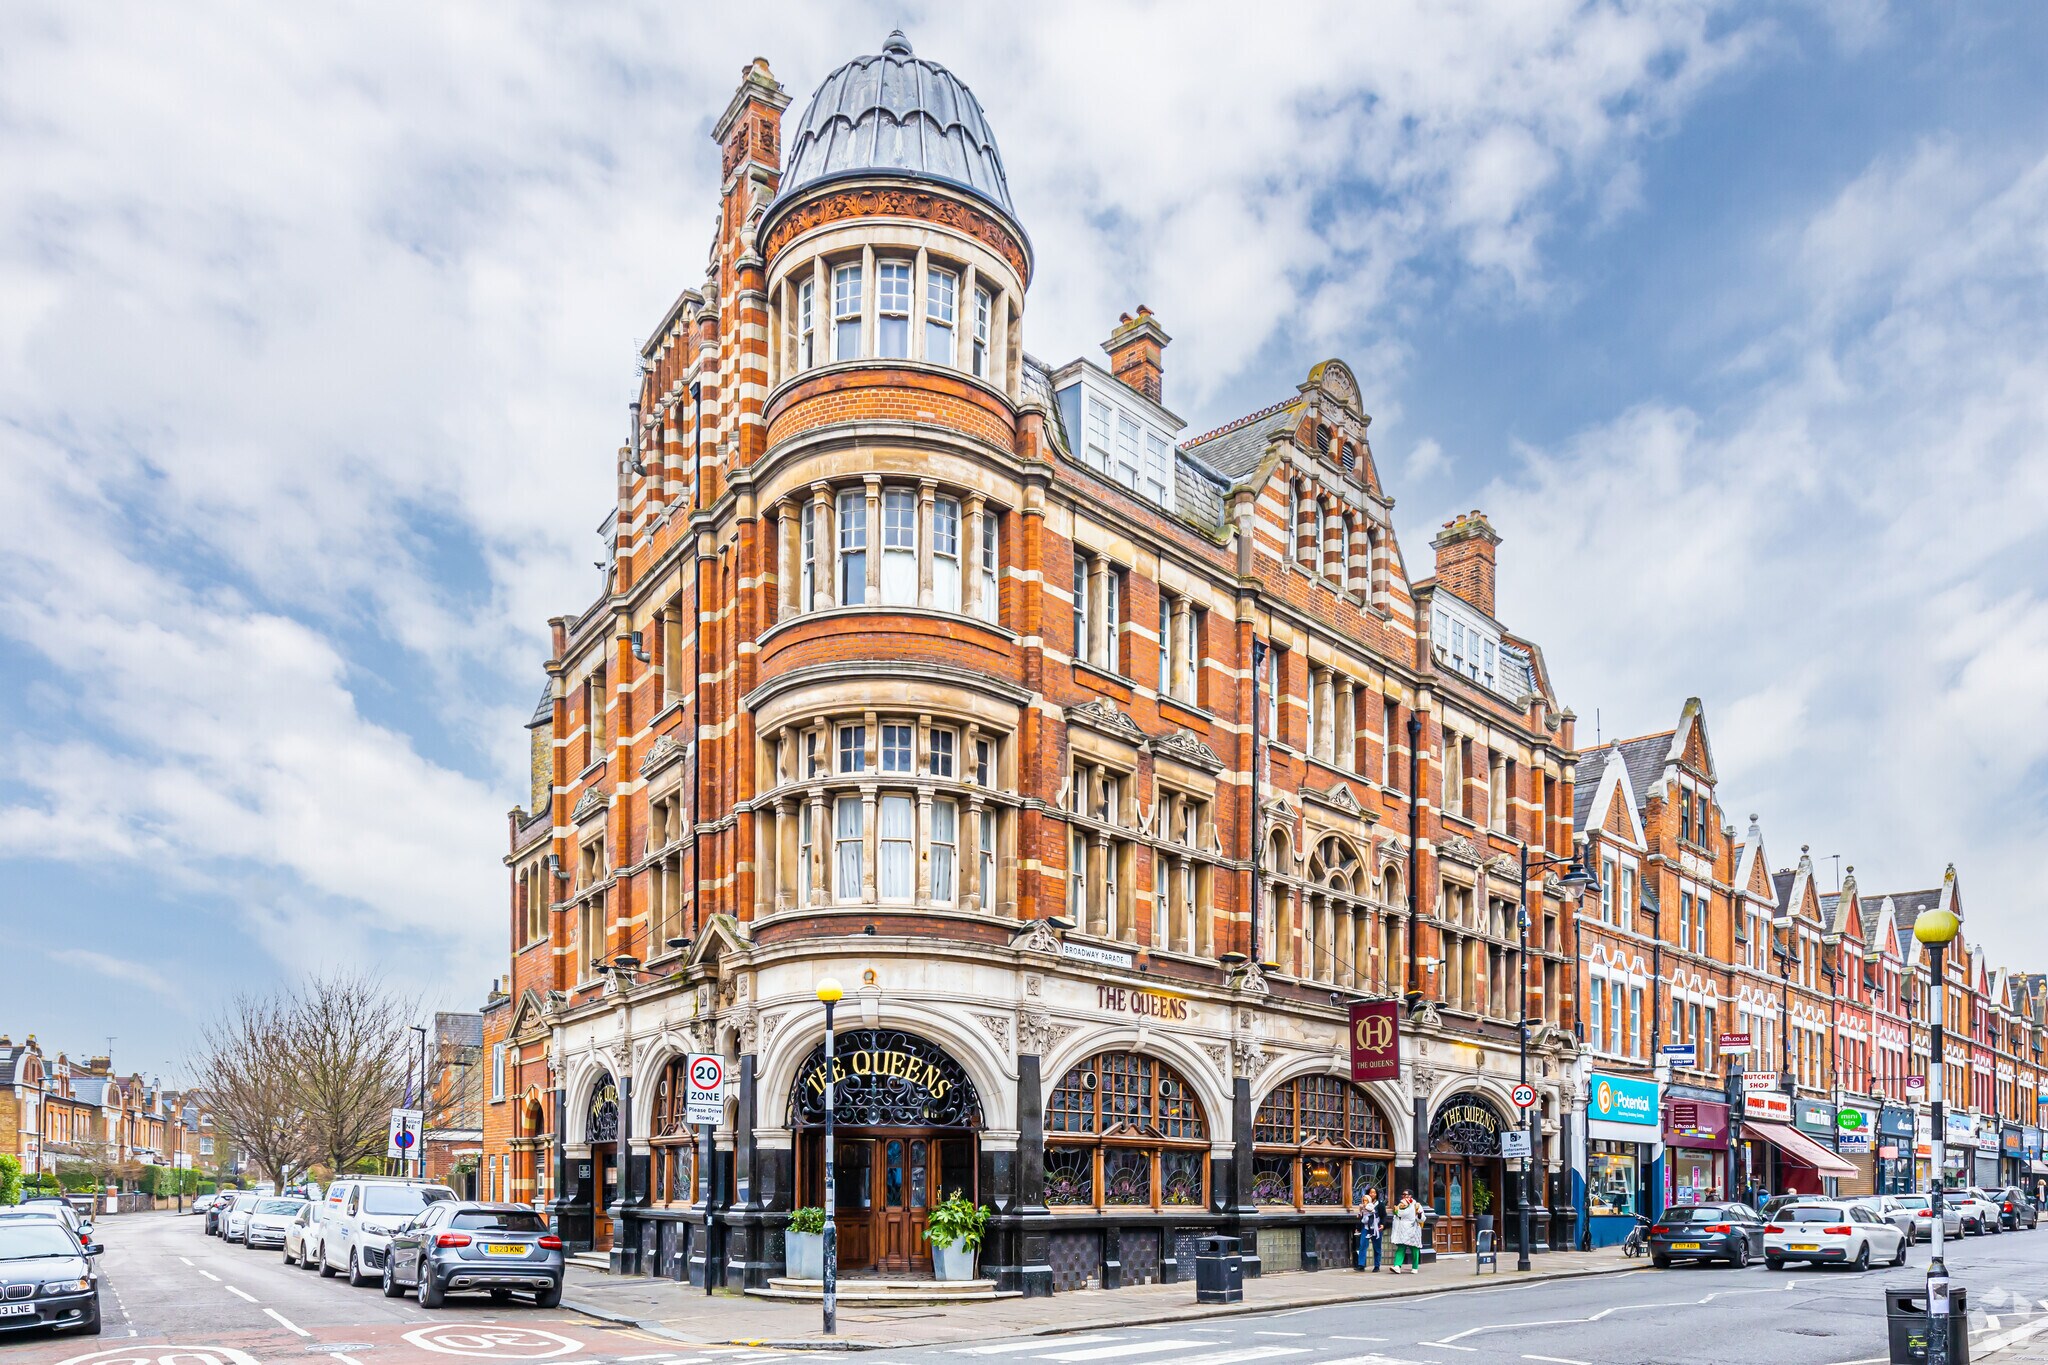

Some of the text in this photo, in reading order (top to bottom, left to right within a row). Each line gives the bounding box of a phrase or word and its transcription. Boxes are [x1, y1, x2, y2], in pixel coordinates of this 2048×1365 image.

[1064, 945, 1099, 959] BROADWAY
[1101, 952, 1124, 964] PARADE
[1096, 985, 1187, 1020] THE QUEENS
[1357, 1059, 1394, 1069] THE QUEENS
[695, 1066, 717, 1080] 20
[807, 1050, 952, 1099] THE QUEENS
[690, 1091, 720, 1102] ZONE
[1515, 1091, 1532, 1101] 20
[696, 1114, 715, 1122] Slowly
[1443, 1105, 1496, 1134] THE QUEENS
[1840, 1135, 1867, 1143] REAL
[489, 1244, 524, 1253] LS20 KNC
[0, 1304, 31, 1315] 3 LNE
